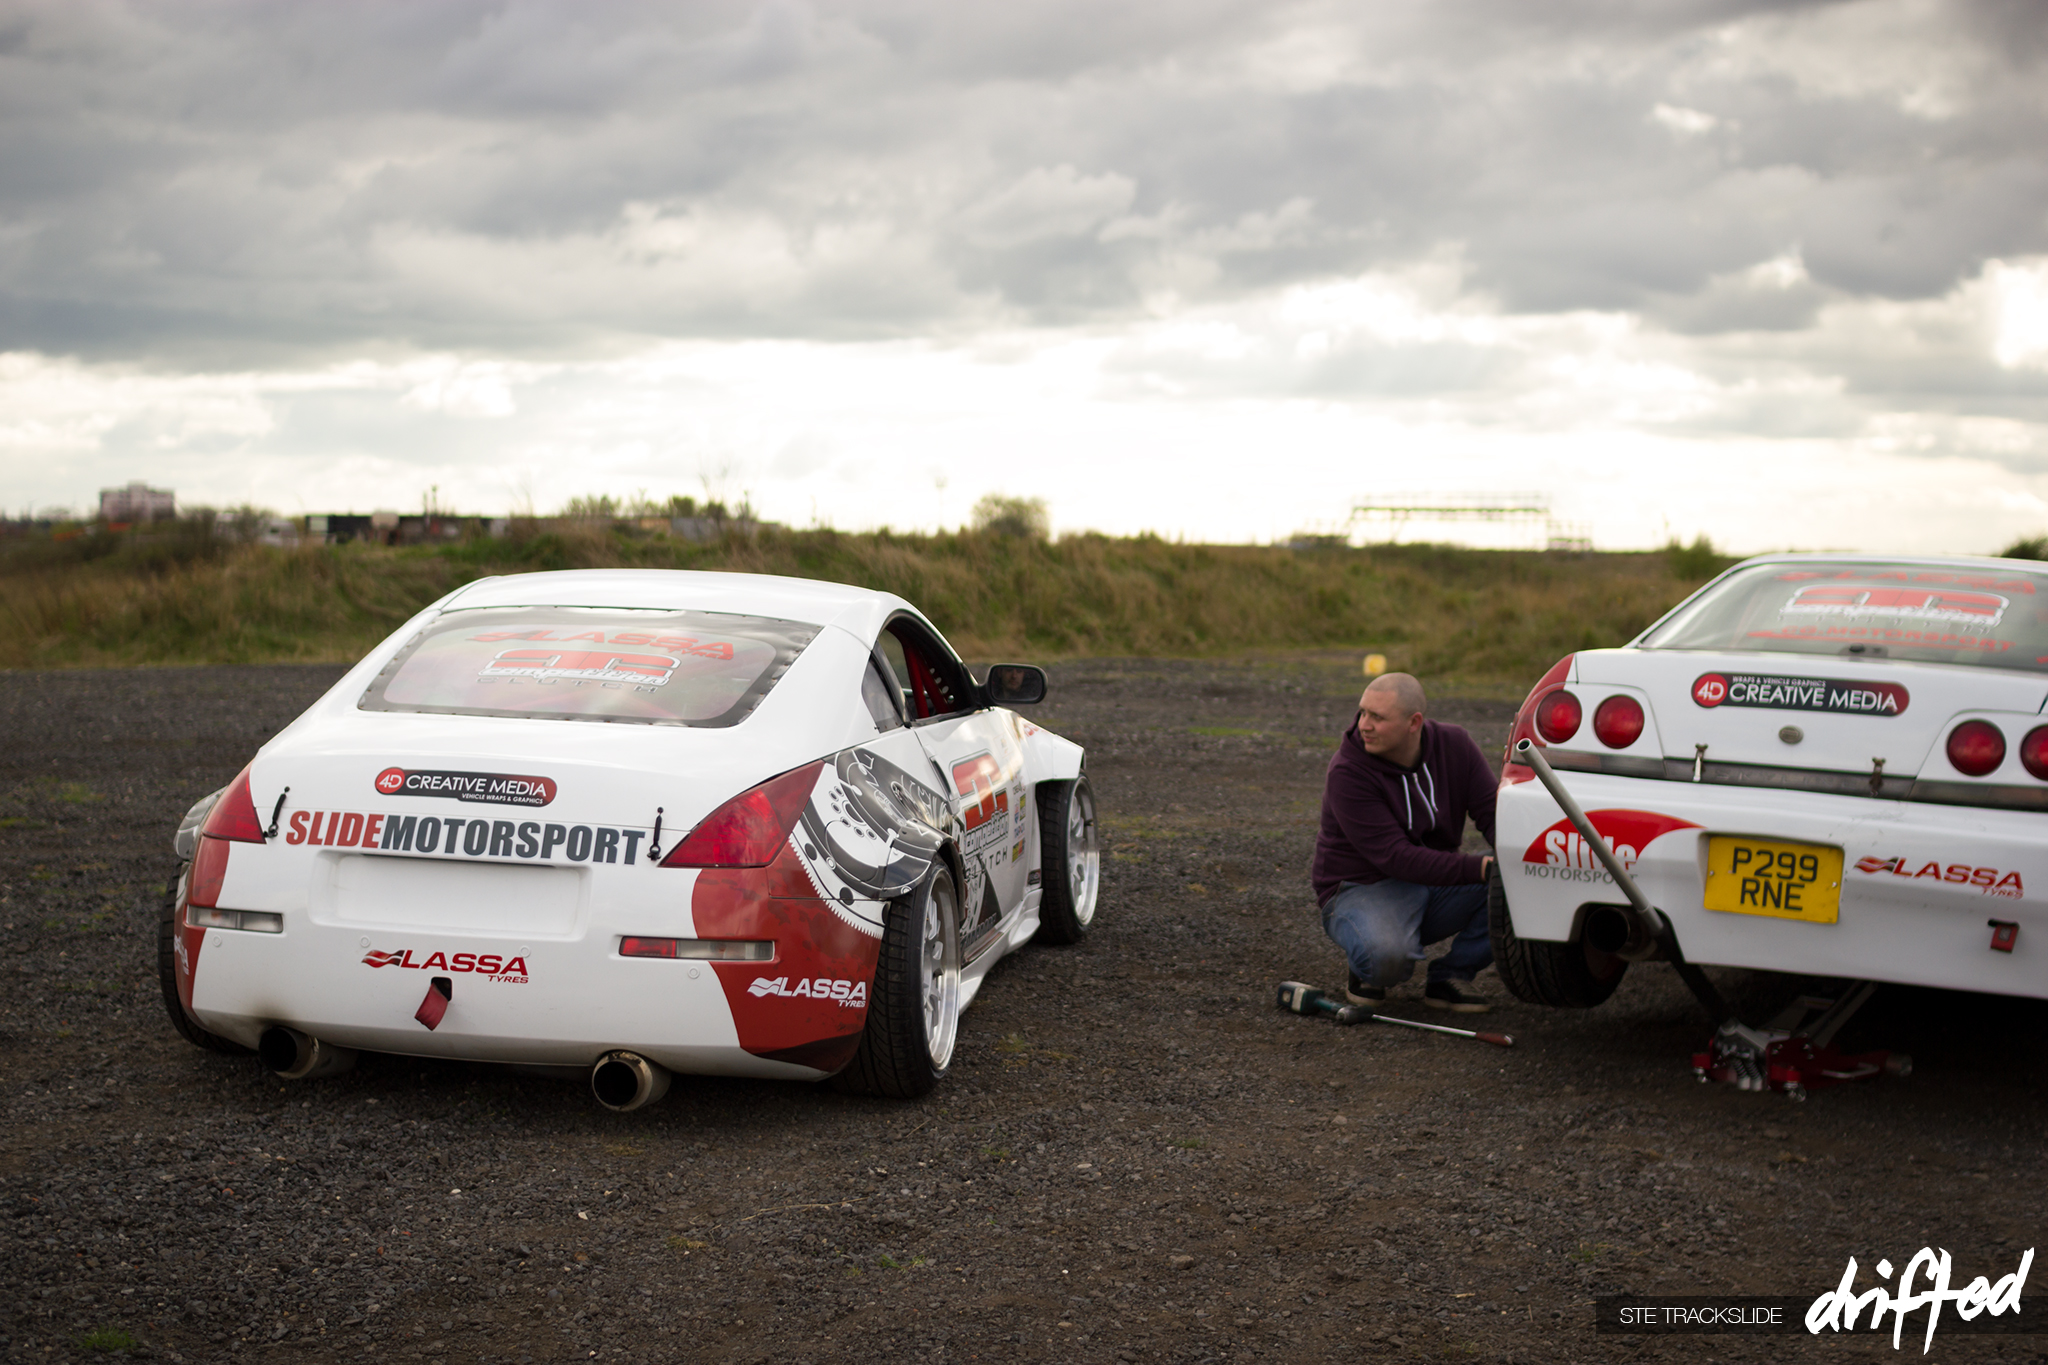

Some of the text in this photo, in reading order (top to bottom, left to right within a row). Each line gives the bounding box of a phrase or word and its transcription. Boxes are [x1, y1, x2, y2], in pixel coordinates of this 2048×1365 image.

[526, 629, 734, 658] LASSA
[475, 676, 659, 693] CLUTCH
[1732, 675, 1756, 684] WRAPS
[1762, 677, 1790, 686] VEHICLE
[1791, 679, 1826, 687] GRAPHICS
[1697, 680, 1899, 713] 4D CREATIVE MEDIA
[378, 773, 547, 797] 4D CREATIVE MEDIA
[486, 794, 506, 802] WRAPS
[512, 796, 544, 804] GRAPHICS
[1524, 864, 1638, 885] MOTORSPOT
[1731, 846, 1819, 883] P299
[1893, 857, 2024, 890] LASSA
[1739, 877, 1806, 912] RNE
[400, 950, 529, 976] LASSA
[487, 974, 529, 985] TYRES
[777, 977, 867, 1000] LASSA
[837, 998, 866, 1008] TYRES
